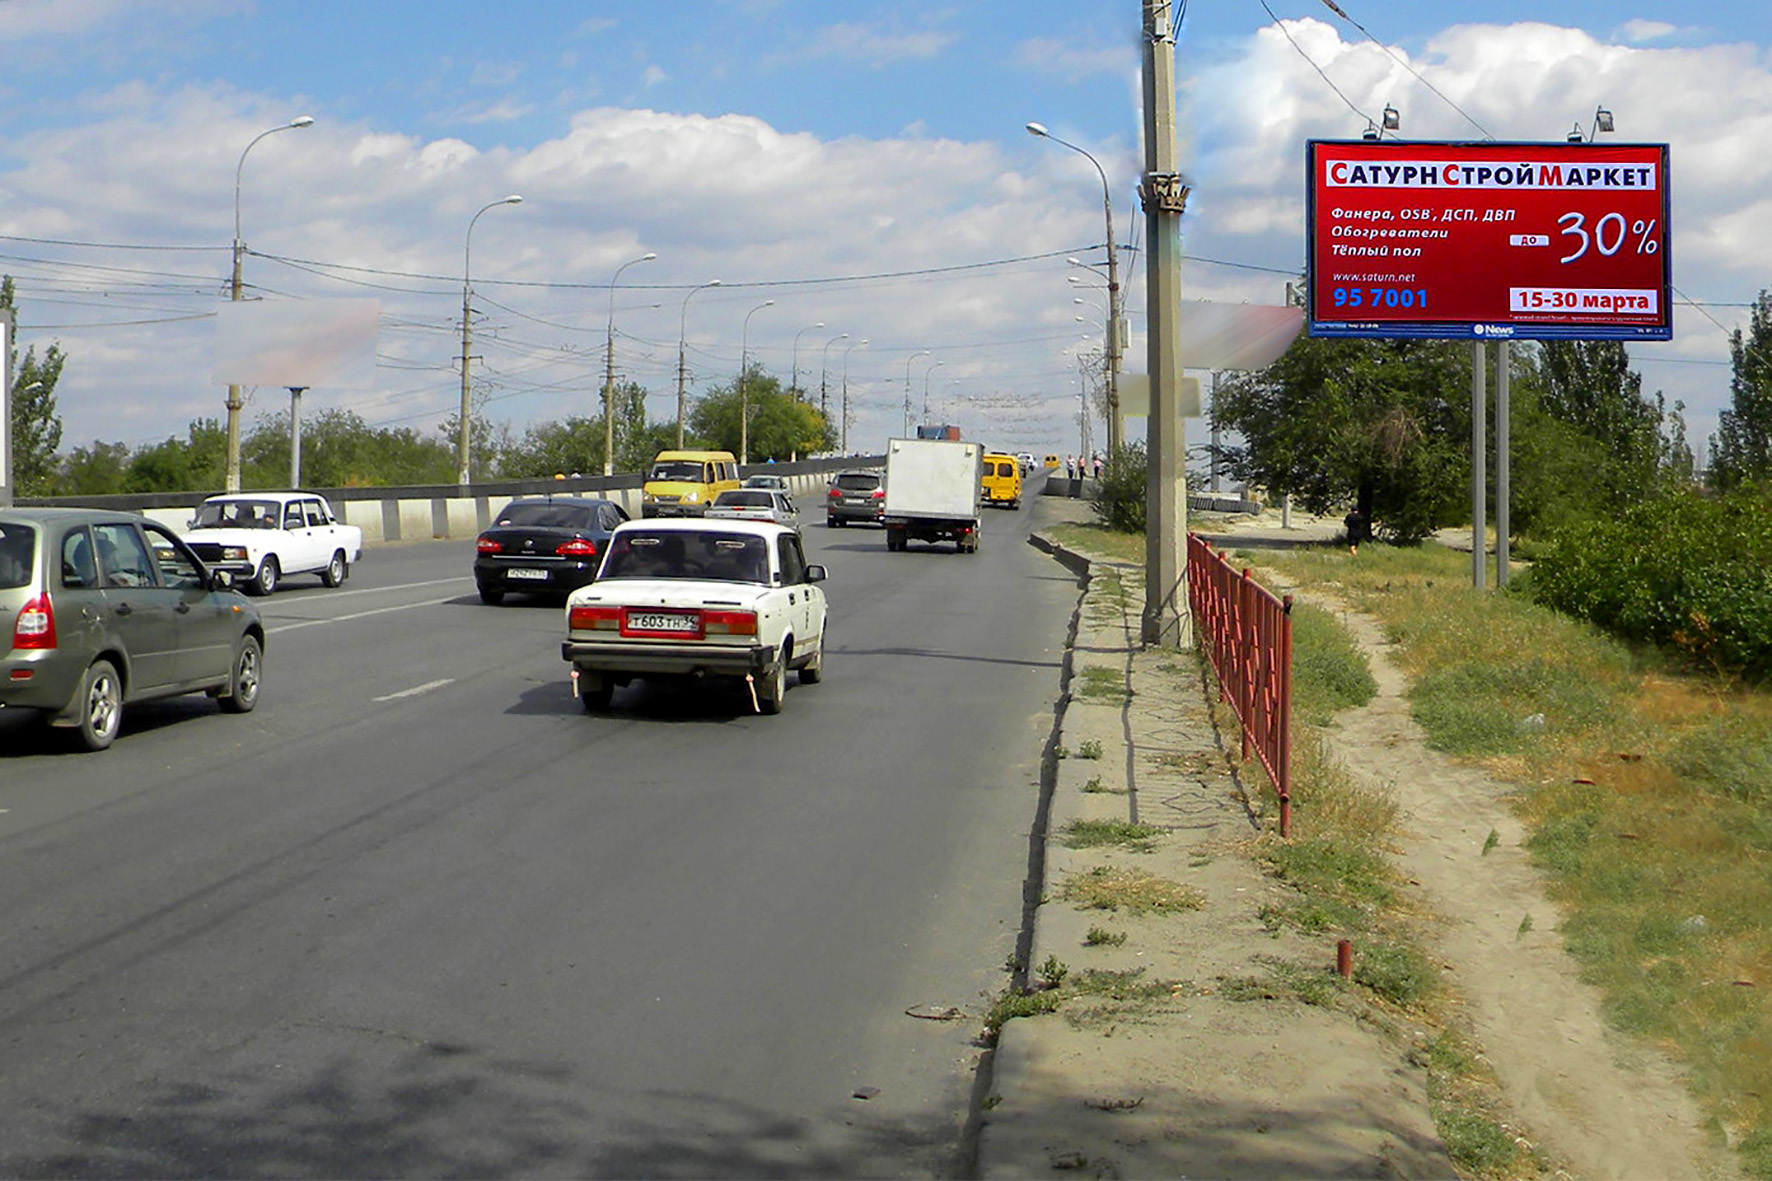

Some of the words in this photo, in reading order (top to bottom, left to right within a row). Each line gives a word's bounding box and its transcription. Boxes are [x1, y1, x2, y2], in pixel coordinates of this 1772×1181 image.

[1331, 208, 1395, 222] Фанера,
[1441, 209, 1478, 222] ДСП,
[1482, 209, 1516, 222] ДВП
[1331, 226, 1449, 240] Обогреватели
[1331, 244, 1388, 257] Тёплый
[1392, 247, 1422, 257] пол
[1333, 273, 1416, 283] www.saturn.net
[1333, 287, 1363, 307] 95
[1370, 288, 1427, 308] 7001
[1519, 291, 1577, 308] 15-30
[1583, 295, 1649, 313] марта
[1485, 325, 1514, 335] News
